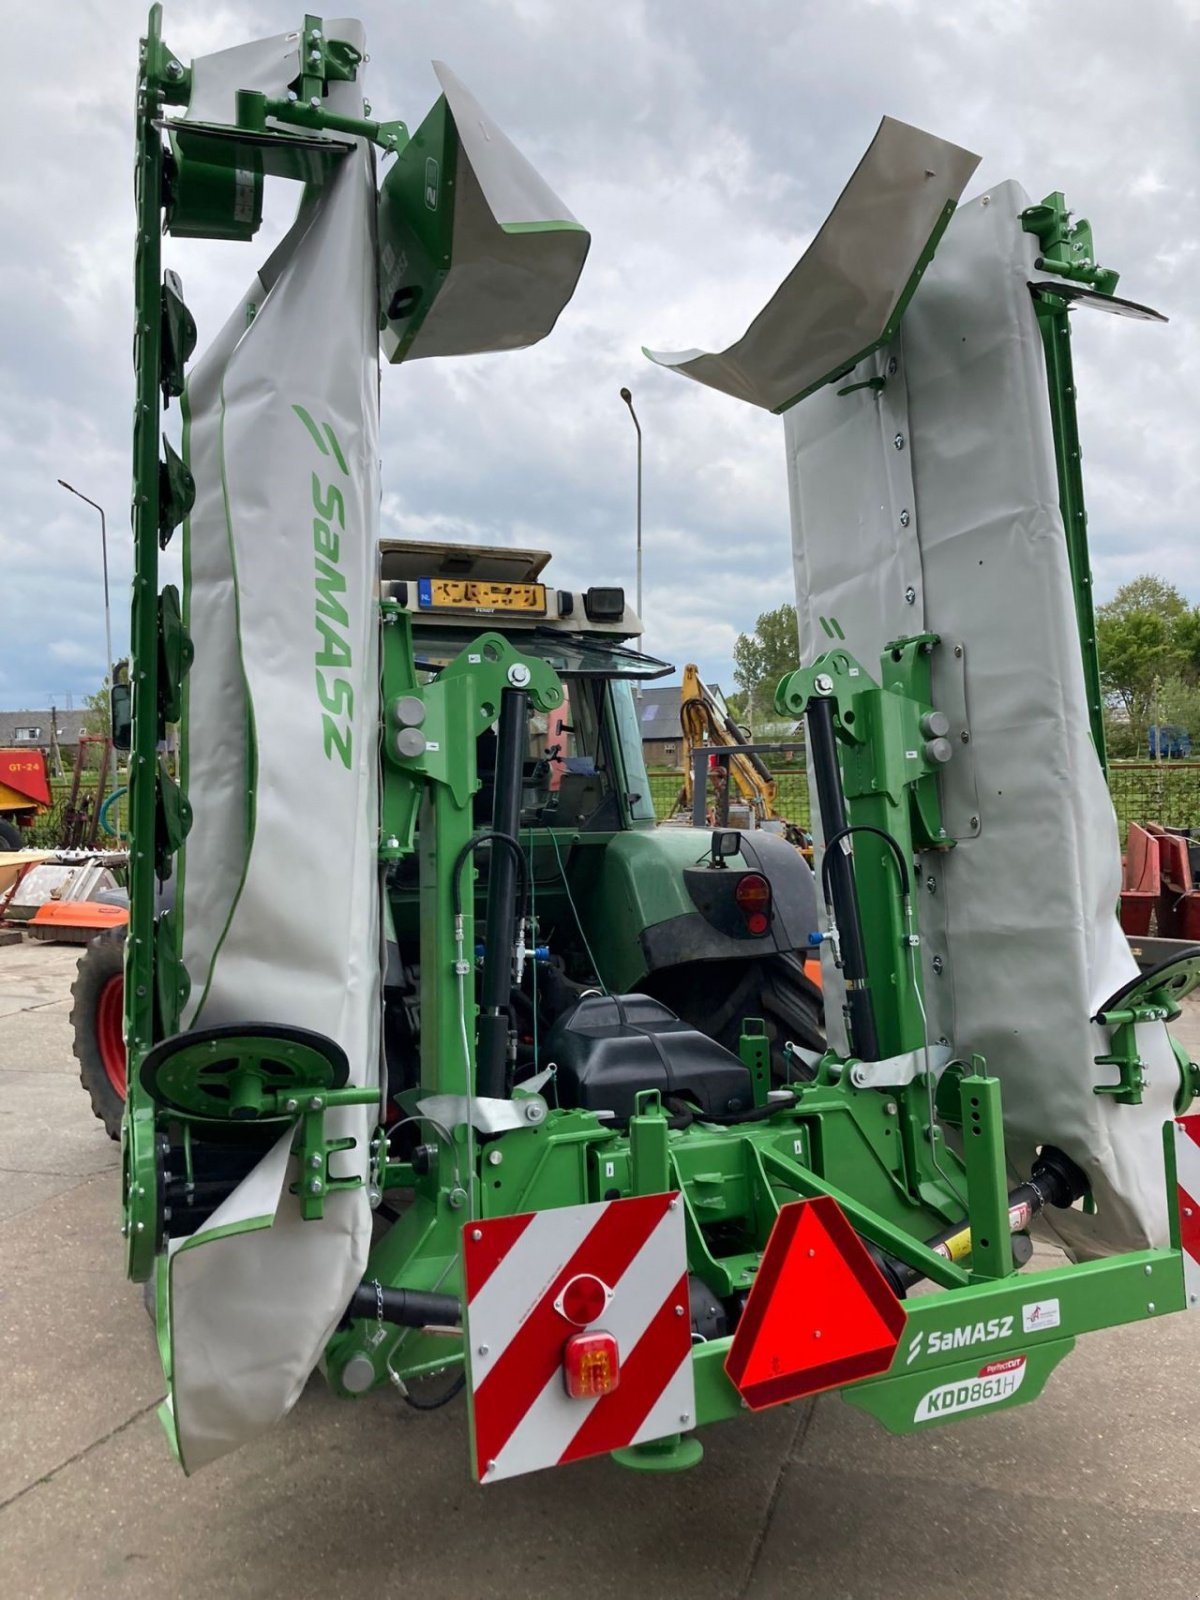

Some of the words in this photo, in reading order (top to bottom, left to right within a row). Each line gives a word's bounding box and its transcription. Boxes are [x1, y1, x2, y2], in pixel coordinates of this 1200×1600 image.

[8, 763, 39, 772] GT-24
[927, 1316, 1014, 1354] SaMASZ
[927, 1374, 1015, 1414] KDD861H
